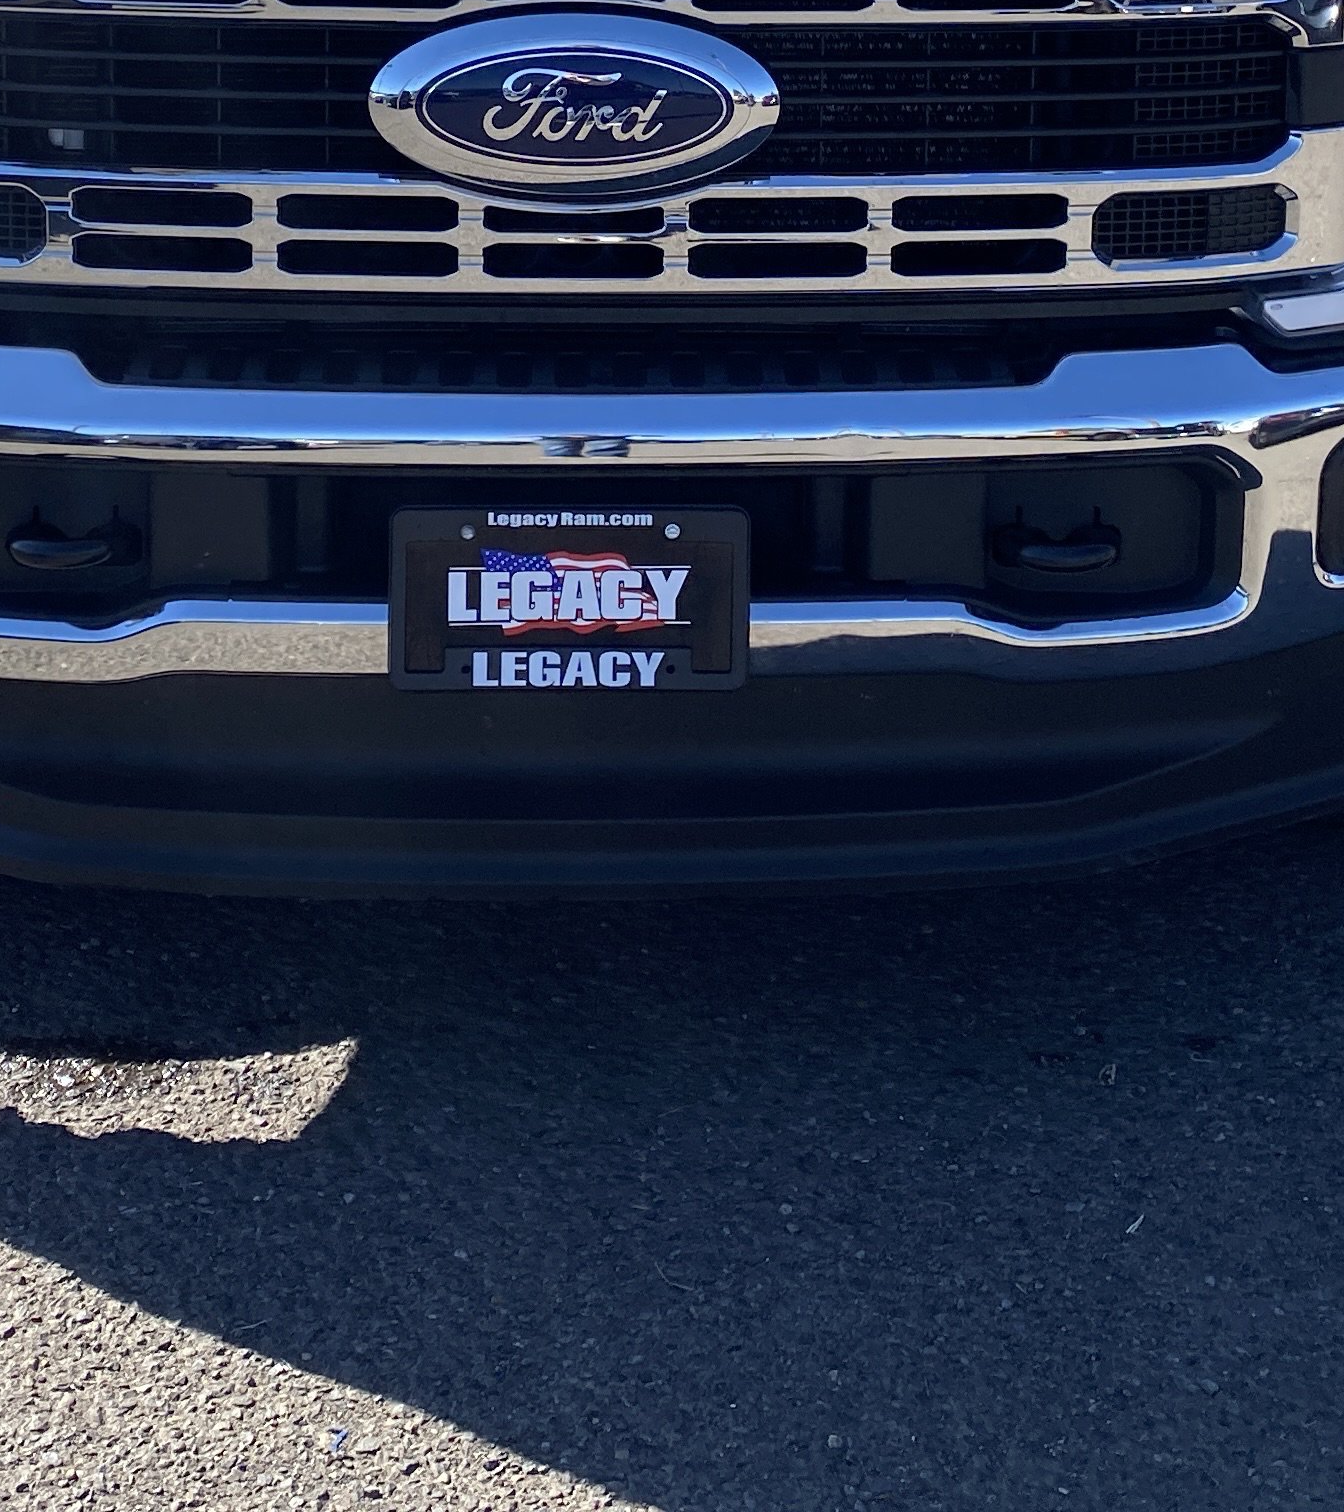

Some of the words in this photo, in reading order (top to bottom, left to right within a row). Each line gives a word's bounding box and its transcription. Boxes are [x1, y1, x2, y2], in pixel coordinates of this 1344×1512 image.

[482, 68, 669, 141] Ford
[447, 569, 690, 622] LEGACY
[472, 651, 665, 687] LEGACY
